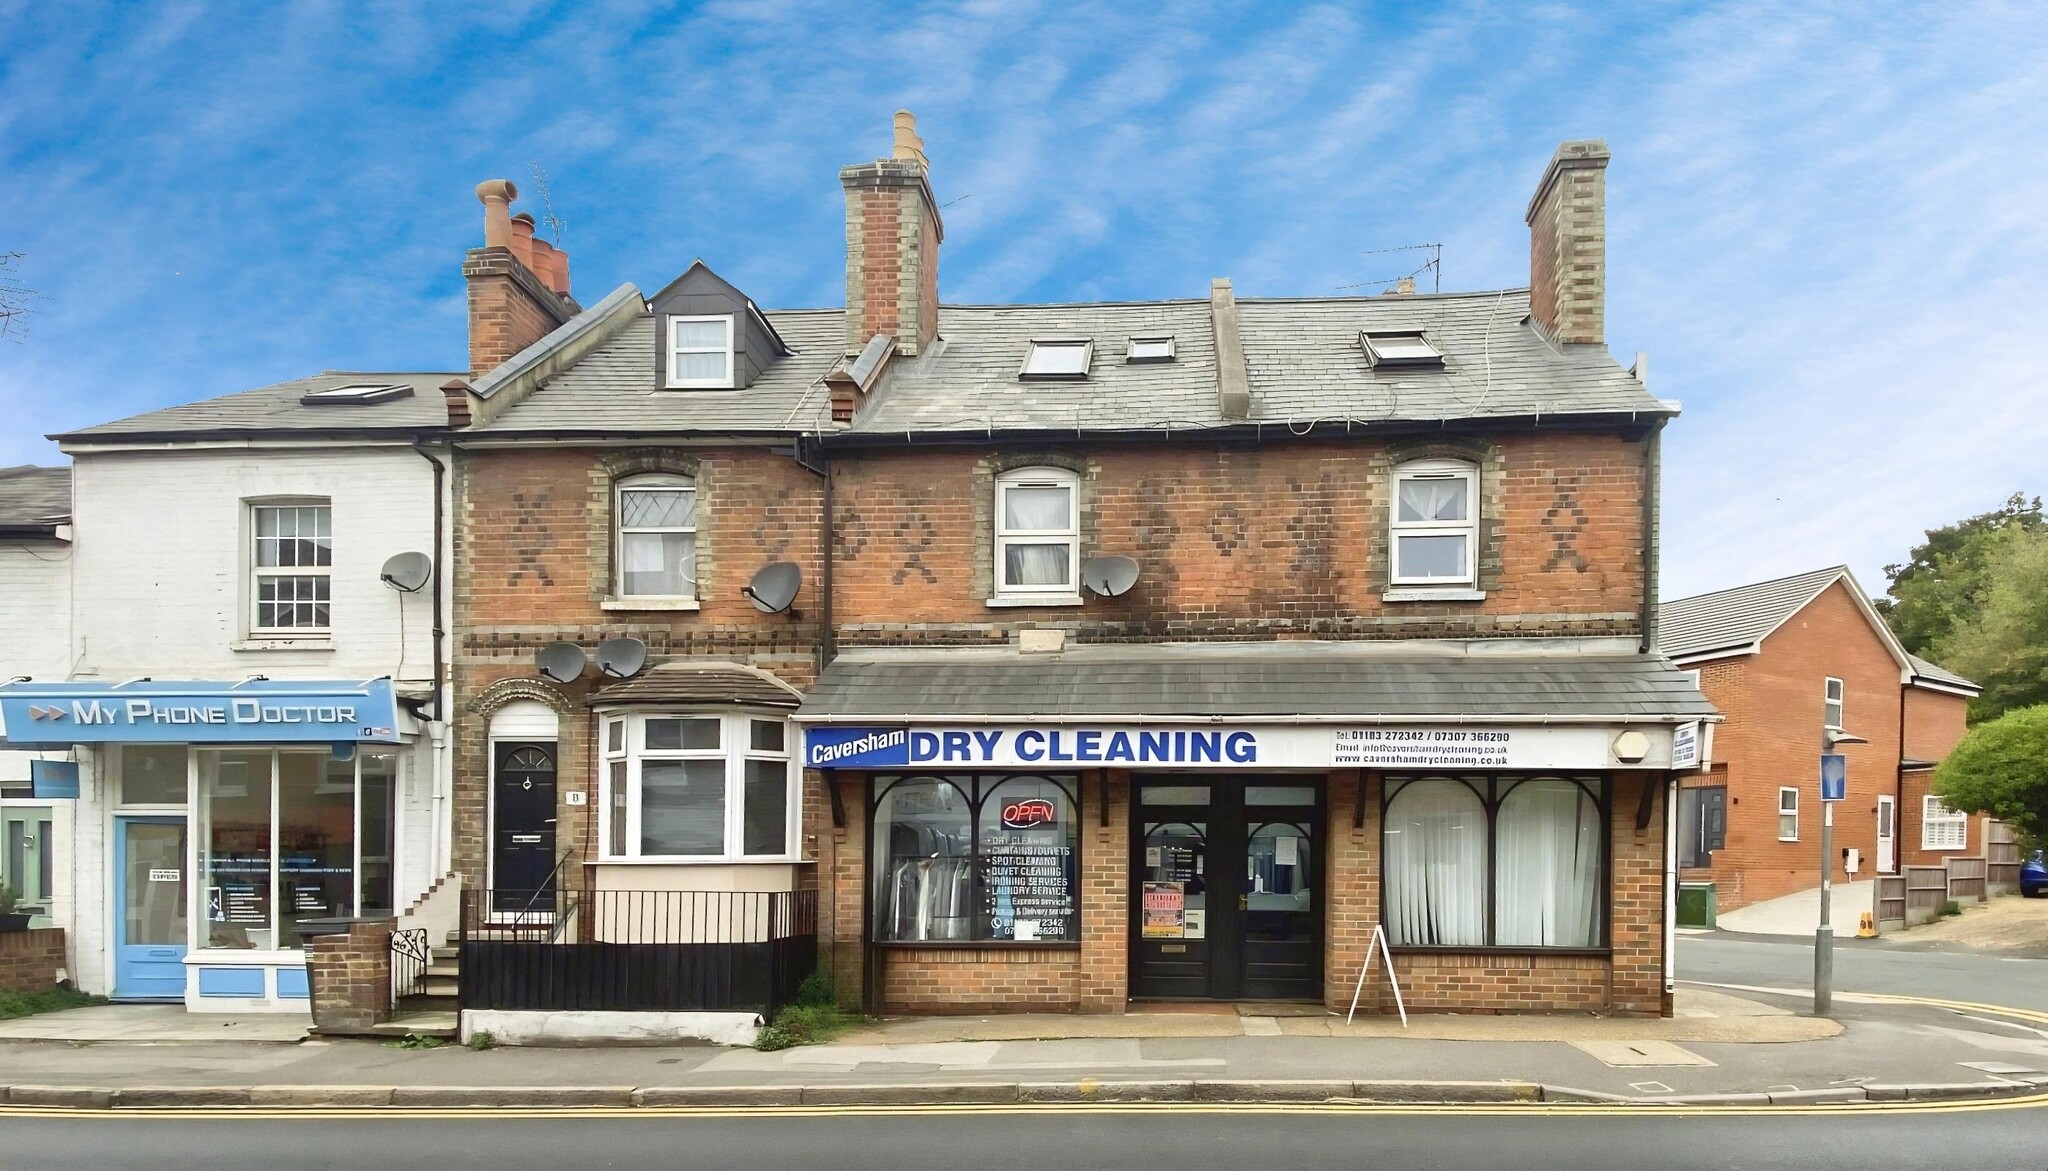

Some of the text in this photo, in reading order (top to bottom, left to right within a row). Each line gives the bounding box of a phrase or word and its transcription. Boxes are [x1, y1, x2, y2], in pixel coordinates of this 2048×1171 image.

[1385, 731, 1424, 741] 272342
[1434, 731, 1467, 742] 07307
[812, 729, 905, 764] Caversham
[910, 730, 1257, 763] DRY CLEANING
[1003, 804, 1055, 822] OPEN
[991, 856, 1013, 866] SPOT
[991, 867, 1062, 876] DUVET CLEANING
[991, 877, 1068, 886] IRONING SERVICES
[991, 886, 1067, 896] LAUNDRY SERVICE
